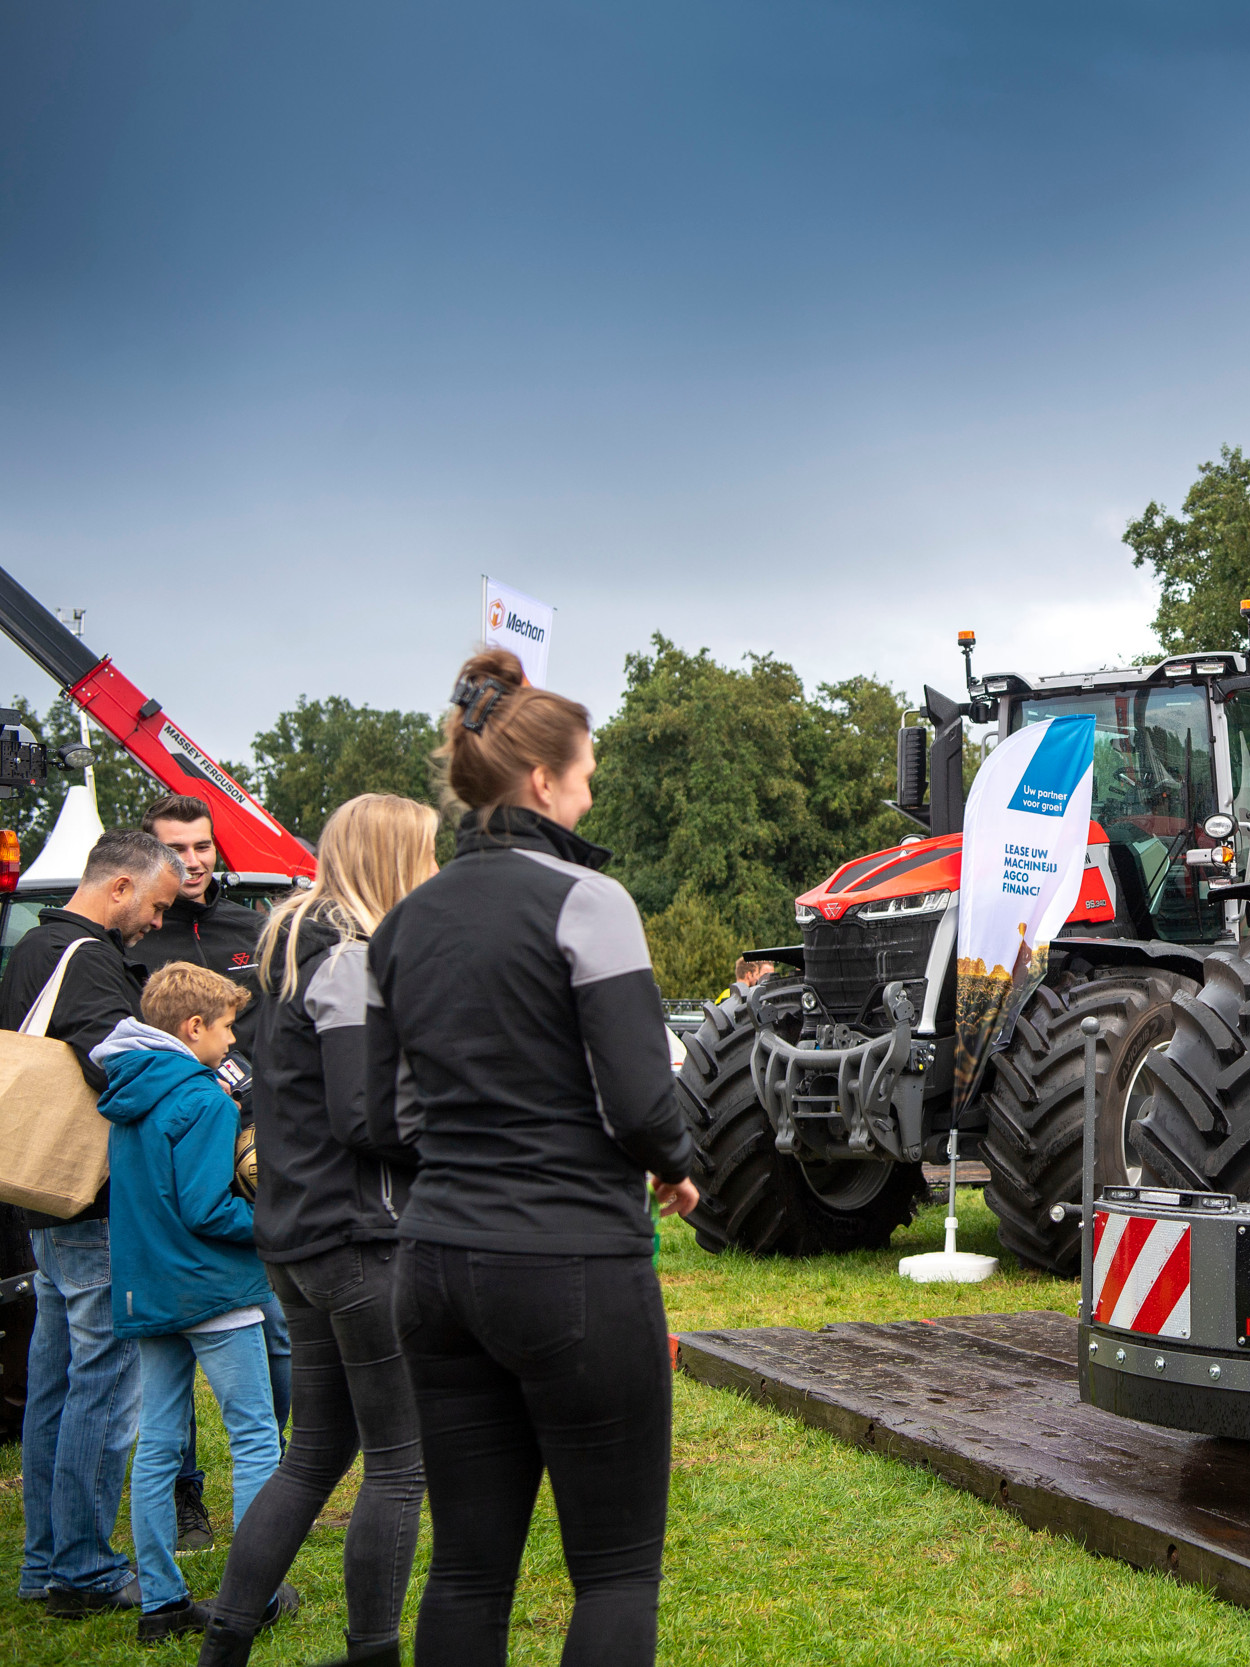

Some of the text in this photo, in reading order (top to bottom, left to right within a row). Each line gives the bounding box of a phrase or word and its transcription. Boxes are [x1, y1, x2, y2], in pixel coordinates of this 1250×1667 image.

[506, 611, 545, 643] Mechan
[163, 724, 246, 804] MASSEY FERGUSON
[1023, 784, 1068, 802] Uw partner
[1022, 799, 1063, 813] voor groei
[1005, 843, 1048, 859] LEASE UW
[1003, 869, 1029, 882] AGCO
